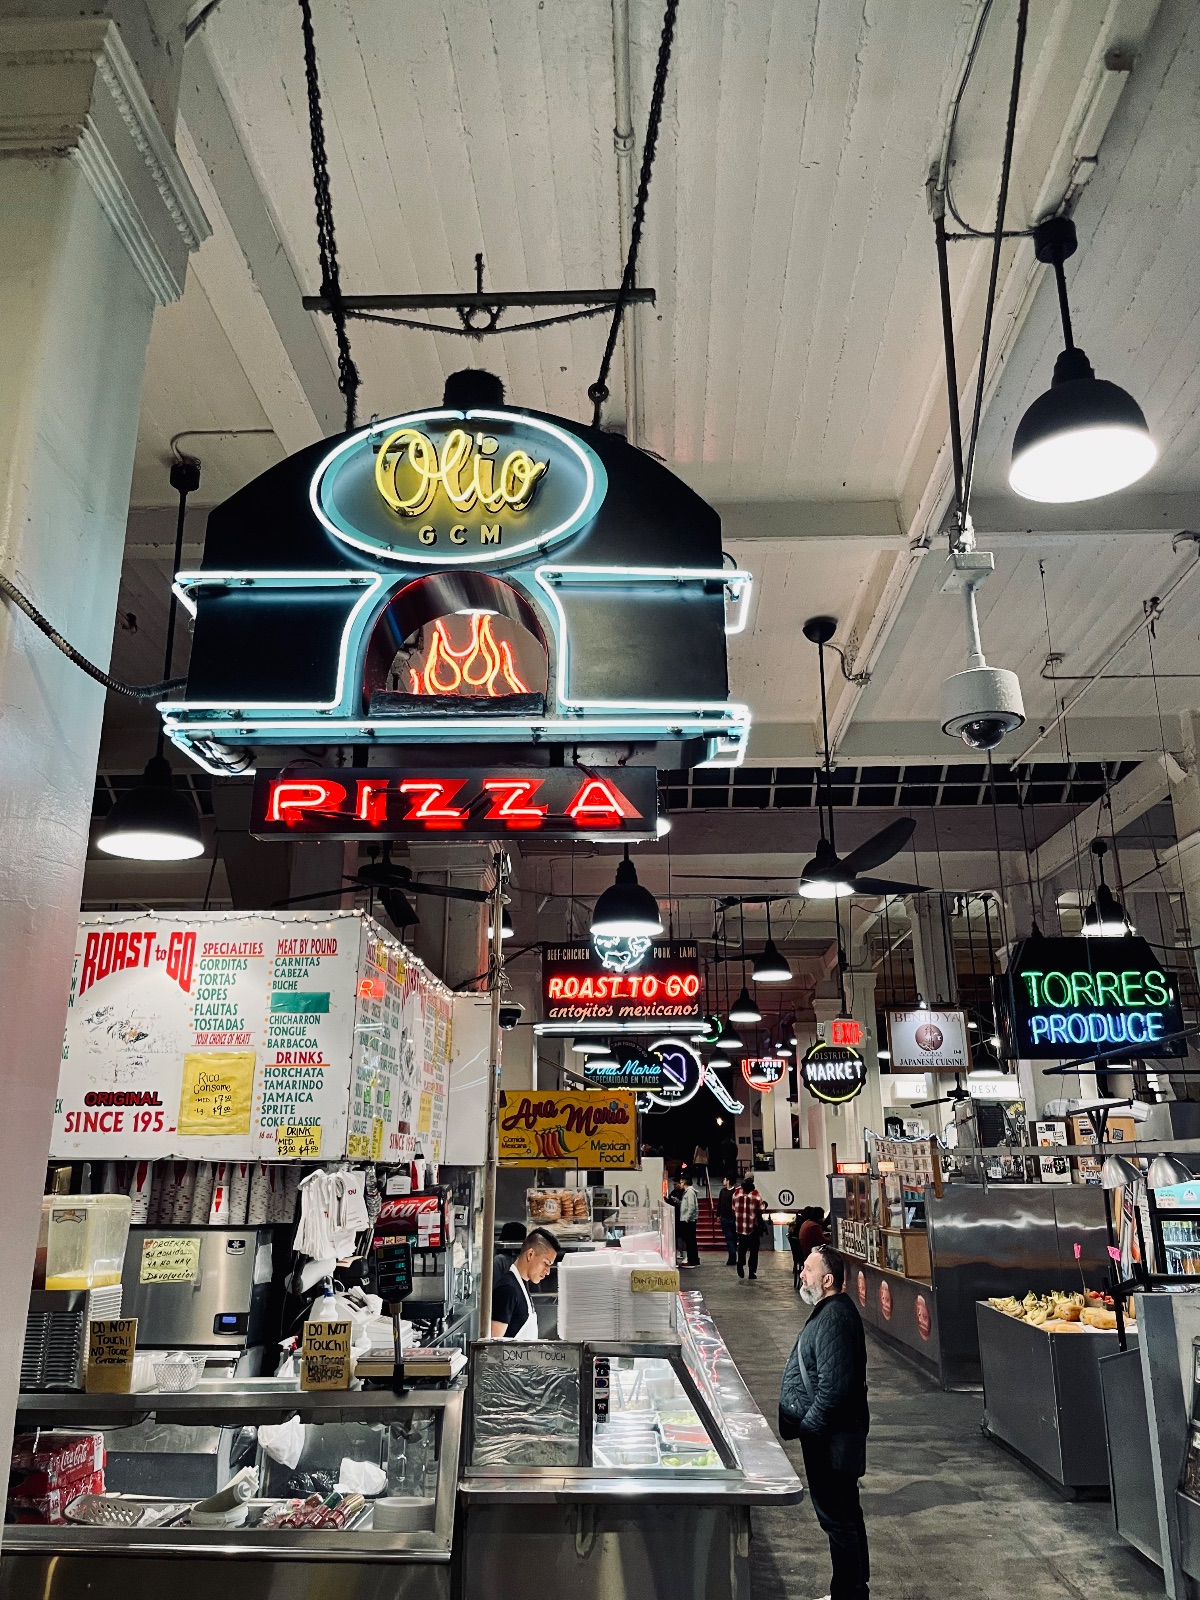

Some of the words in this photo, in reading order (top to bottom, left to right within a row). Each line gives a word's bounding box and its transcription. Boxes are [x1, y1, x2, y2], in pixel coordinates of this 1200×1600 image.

[375, 429, 550, 517] Olio
[264, 778, 643, 822] PIZZA
[203, 942, 264, 955] SPECIALTIES
[277, 939, 298, 955] MEAT
[299, 938, 310, 954] BY
[311, 938, 338, 954] POUND
[79, 931, 157, 998] ROAST
[155, 944, 168, 961] to
[166, 931, 197, 994] GO
[200, 958, 249, 971] GORDITAS
[275, 957, 321, 967] CARNITAS
[274, 968, 309, 978] CABEZA
[199, 973, 237, 986] TORTAS
[272, 980, 299, 990] BUCHE
[549, 976, 624, 999] ROAST
[628, 975, 659, 998] TO
[665, 974, 699, 997] GO
[1021, 970, 1170, 1008] TORRES
[196, 988, 228, 1001] SOPES
[194, 1003, 239, 1016] FLAUTAS
[549, 1002, 614, 1023] antojitos
[618, 1001, 699, 1017] mexicanos
[269, 1015, 321, 1025] CHICHARRON
[894, 1012, 940, 1023] BENTO
[943, 1012, 961, 1022] YA
[194, 1018, 245, 1031] TOSTADAS
[1028, 1012, 1165, 1045] PRODUCE
[269, 1026, 307, 1036] TONGUE
[832, 1021, 860, 1045] EXIT
[209, 1033, 227, 1045] CHOICE
[227, 1033, 235, 1045] OF
[234, 1033, 252, 1045] MEATS
[267, 1038, 319, 1049] BARBACOA
[276, 1051, 323, 1064] DRINKS
[814, 1051, 850, 1060] DISTRICT
[899, 1058, 935, 1066] JAPANESE
[936, 1058, 965, 1066] CUISINE
[198, 1071, 220, 1084] Rico
[264, 1067, 325, 1078] HORCHATA
[805, 1061, 863, 1082] MARKET
[264, 1080, 323, 1090] TAMARINDO
[630, 1075, 639, 1084] EN
[641, 1075, 660, 1084] TACOS
[193, 1084, 232, 1095] Consome
[84, 1091, 163, 1107] ORIGINAL
[262, 1092, 314, 1103] JAMAICA
[261, 1104, 296, 1115] SPRITE
[64, 1111, 125, 1133] SINCE
[260, 1116, 285, 1127] COKE
[287, 1116, 322, 1127] CLASSIC
[501, 1097, 559, 1131] Ana
[560, 1103, 630, 1137] Maria
[286, 1126, 312, 1137] DRINK
[502, 1135, 526, 1143] Comida
[590, 1140, 631, 1151] Mexican
[599, 1152, 625, 1163] Food
[92, 1321, 106, 1335] DO
[109, 1320, 133, 1333] NOT
[308, 1323, 323, 1336] DO
[327, 1322, 349, 1336] NOT
[91, 1347, 105, 1357] NO
[539, 1350, 566, 1361] TOUCH
